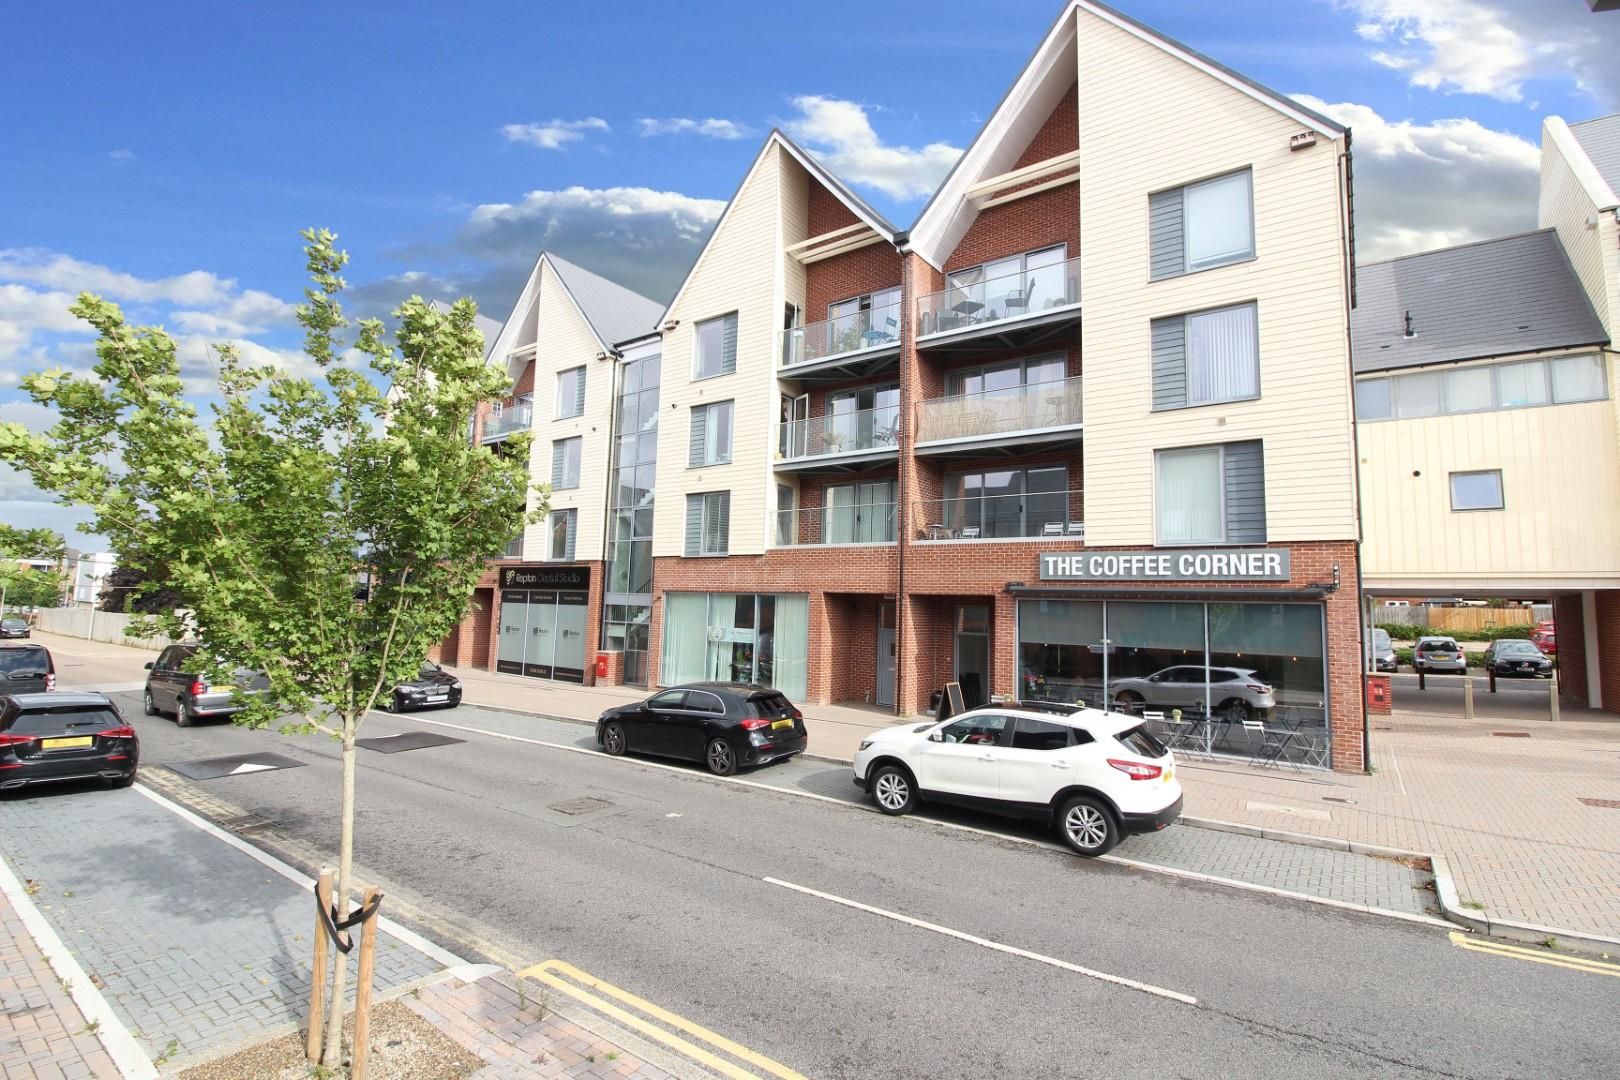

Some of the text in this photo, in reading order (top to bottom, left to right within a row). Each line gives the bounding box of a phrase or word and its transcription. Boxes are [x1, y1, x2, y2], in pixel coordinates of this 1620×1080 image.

[1045, 553, 1282, 576] THE COFFEE CORNER
[516, 573, 537, 584] Repton
